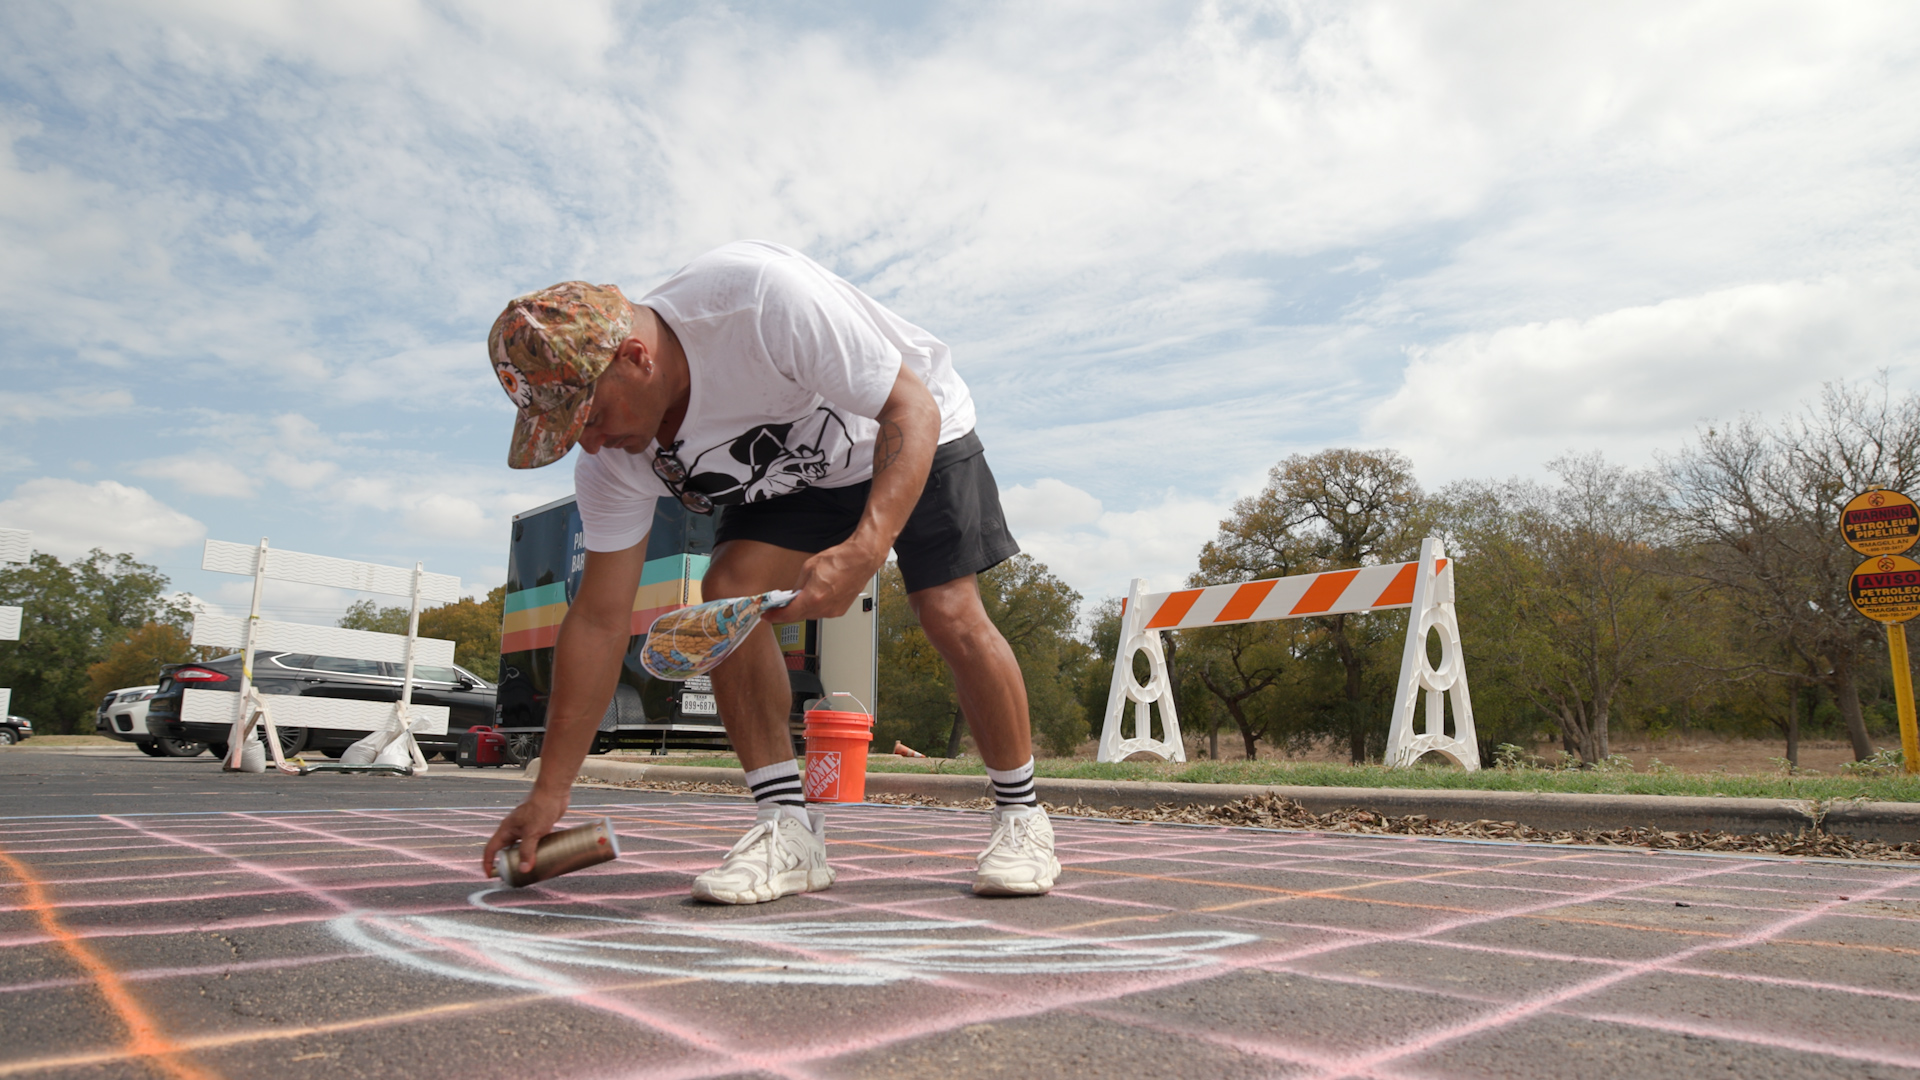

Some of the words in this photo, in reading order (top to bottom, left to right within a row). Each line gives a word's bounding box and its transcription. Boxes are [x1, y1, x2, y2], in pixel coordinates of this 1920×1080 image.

[1851, 507, 1909, 522] WARNING
[1846, 517, 1917, 532] PETROLEUM
[1856, 526, 1909, 539] PIPELINE
[1864, 539, 1909, 547] MAGELLAN
[1863, 573, 1917, 586] AVISO
[1859, 586, 1920, 597] PETROLEO
[1856, 594, 1920, 605] OLEODUCT
[807, 756, 819, 774] THE
[805, 751, 840, 797] HOME
[813, 769, 839, 798] DEPOT
